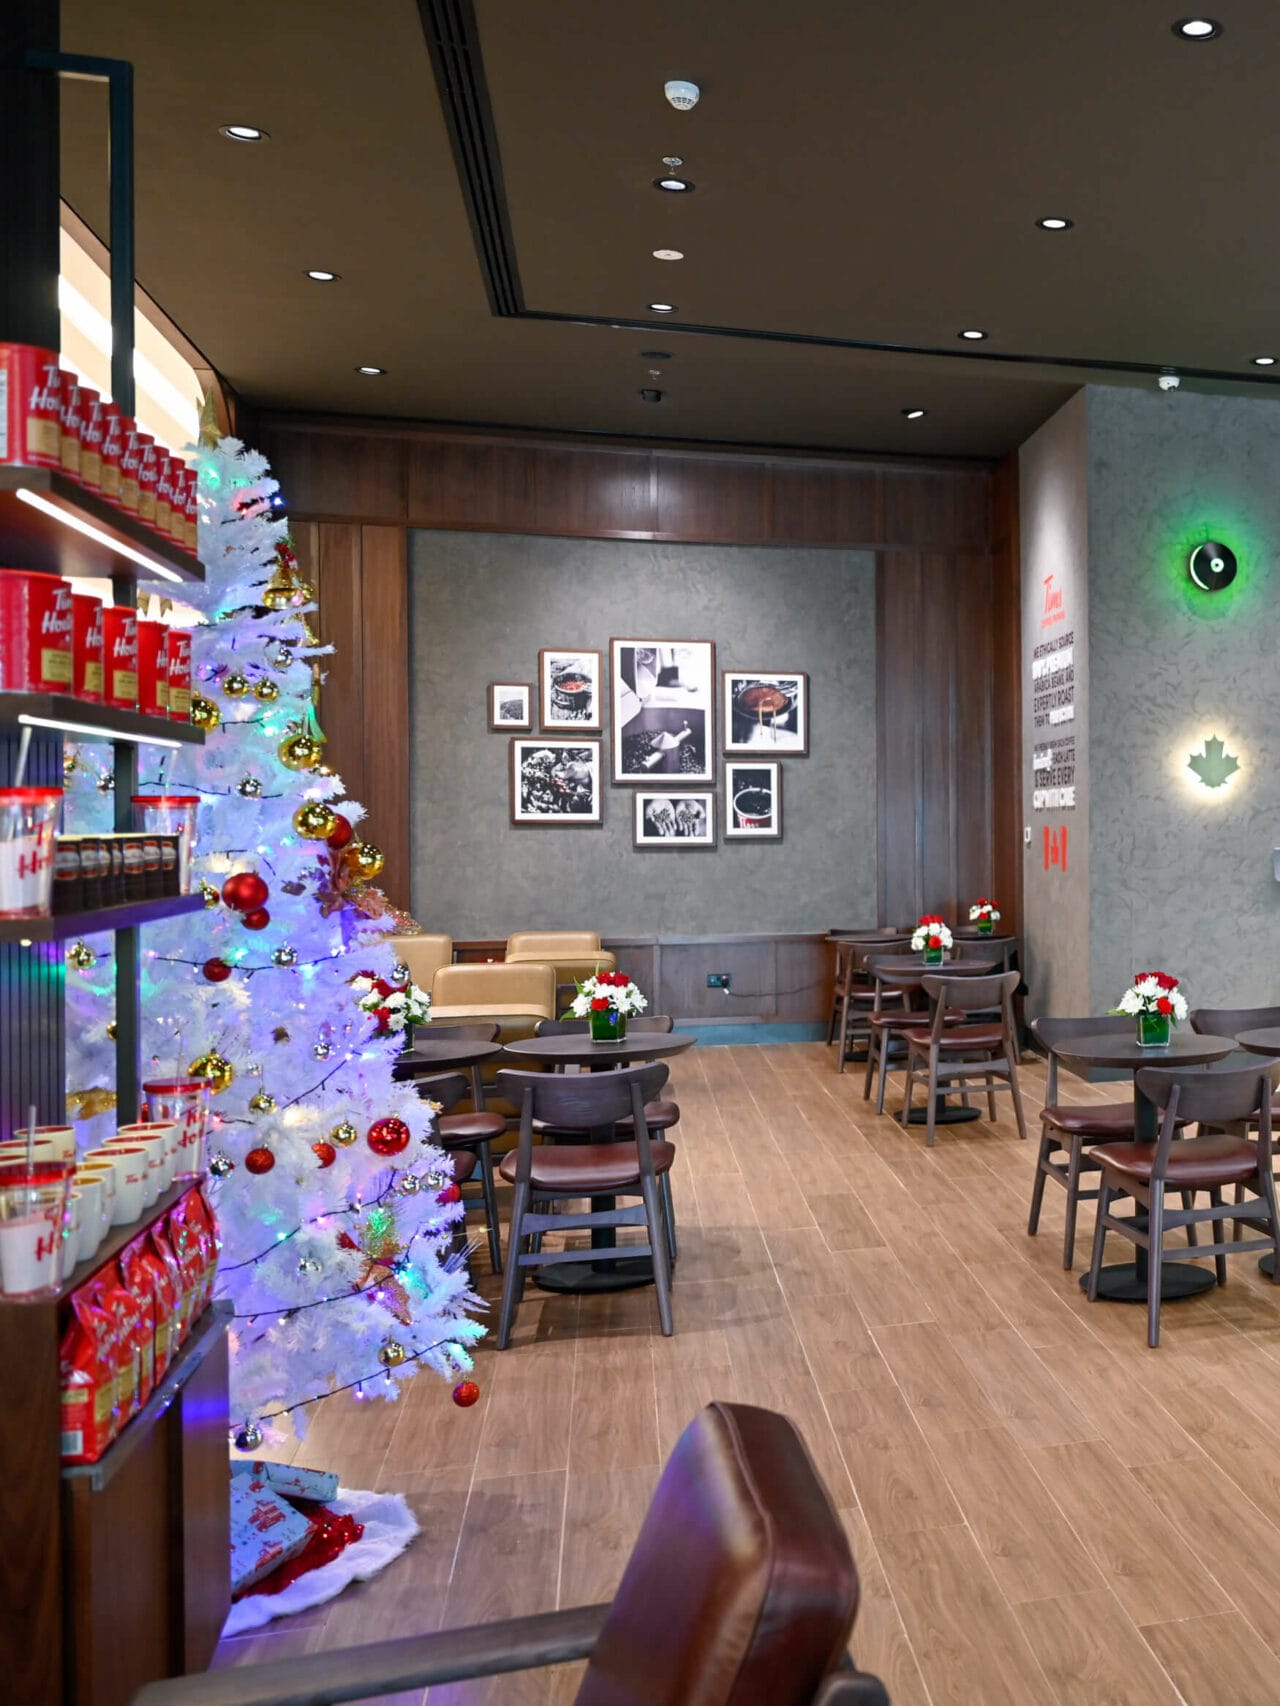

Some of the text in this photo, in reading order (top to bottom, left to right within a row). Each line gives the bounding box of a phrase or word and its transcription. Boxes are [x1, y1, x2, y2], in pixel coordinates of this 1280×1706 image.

[1034, 685, 1074, 713] EXPERTLY ROAST
[1040, 768, 1056, 786] SERVE
[1057, 766, 1074, 785] EVERY
